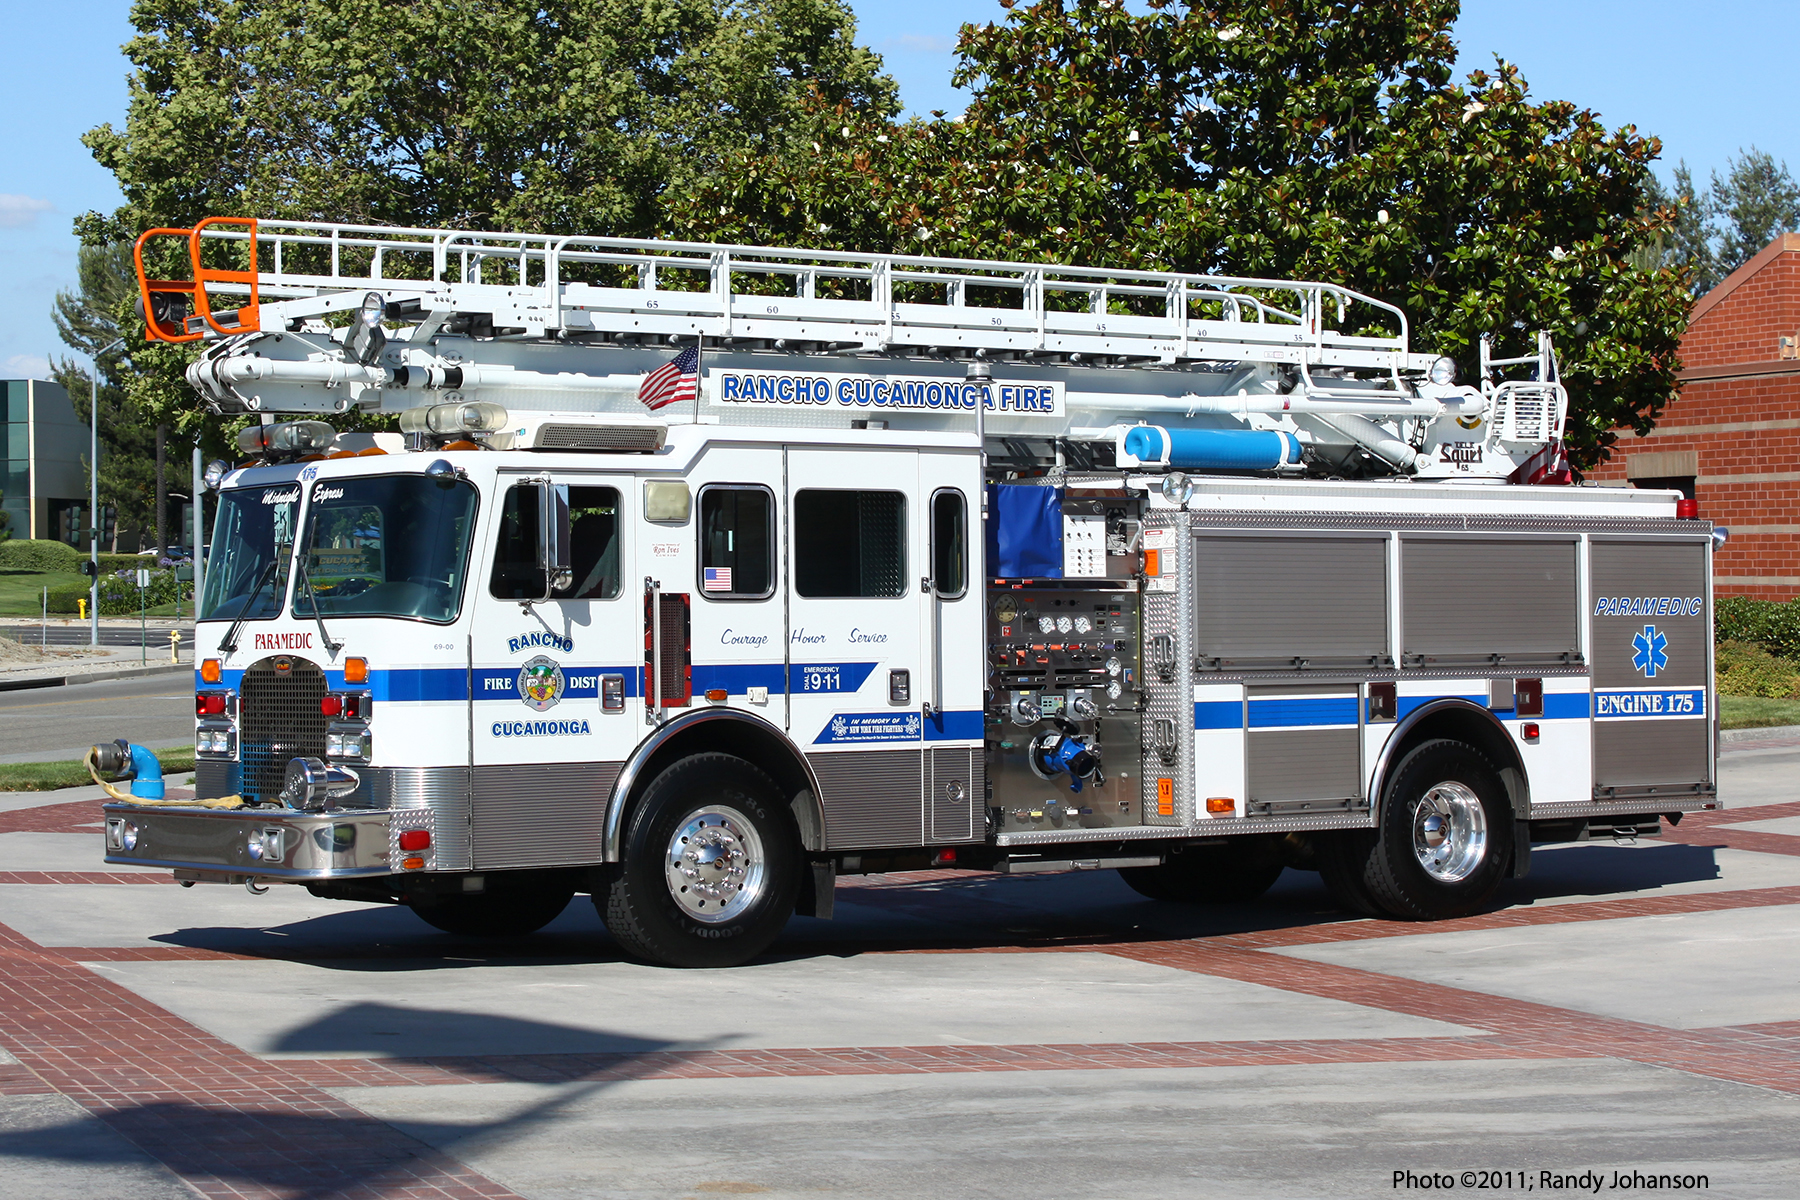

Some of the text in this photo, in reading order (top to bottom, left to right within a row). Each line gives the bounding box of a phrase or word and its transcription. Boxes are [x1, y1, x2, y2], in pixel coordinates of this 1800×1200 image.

[646, 300, 659, 309] 65
[766, 306, 779, 315] 60
[1197, 329, 1208, 337] 40
[1294, 334, 1303, 342] 35
[722, 374, 1055, 413] RANCHO CUCAMONGA FIRE
[302, 467, 318, 480] 175
[262, 483, 344, 508] Midnight Express
[1594, 596, 1702, 616] PARAMEDIC
[255, 632, 313, 650] PARAMEDIC
[506, 630, 575, 654] RANCHO
[721, 627, 889, 648] Courage Honor Service
[433, 643, 454, 651] 69-00
[484, 676, 597, 690] FIRE DIST
[1597, 694, 1694, 714] ENGINE 175
[491, 719, 592, 738] CUCAMONGA
[849, 726, 860, 734] NEW
